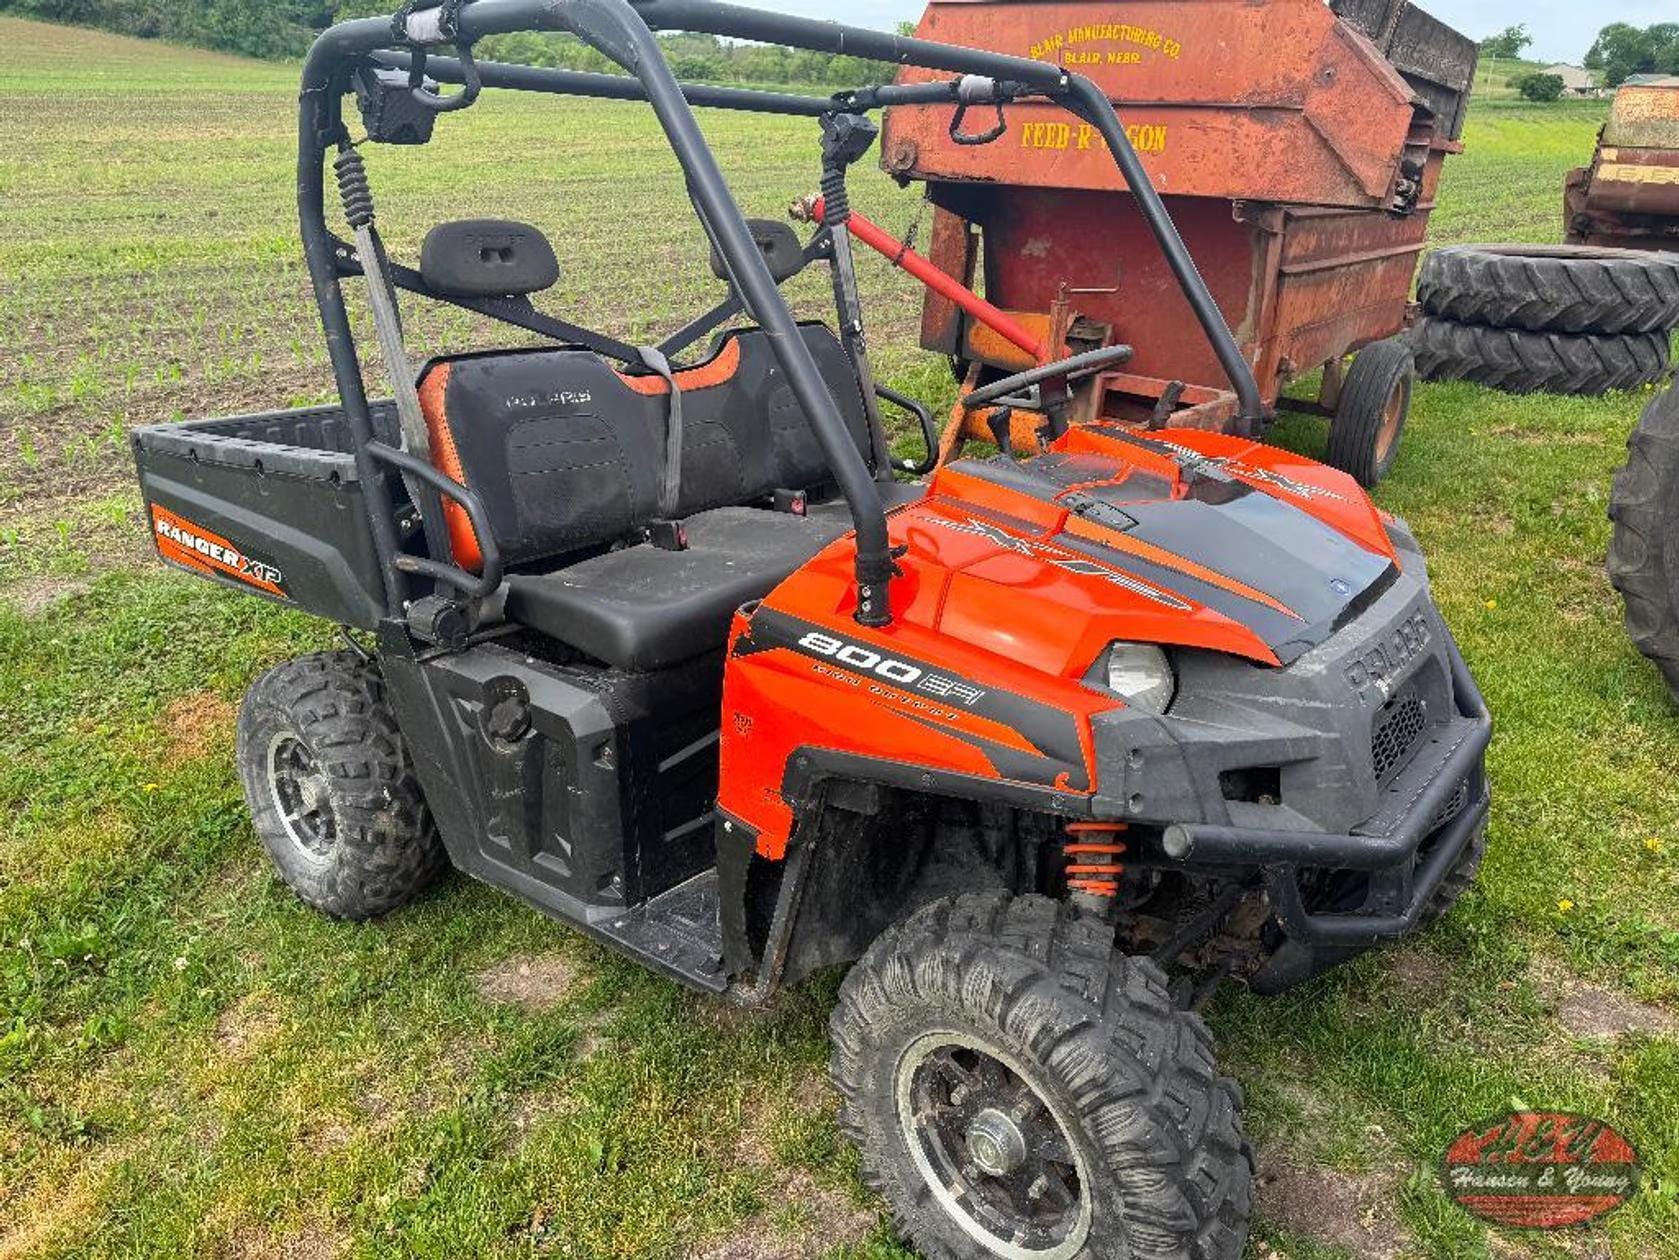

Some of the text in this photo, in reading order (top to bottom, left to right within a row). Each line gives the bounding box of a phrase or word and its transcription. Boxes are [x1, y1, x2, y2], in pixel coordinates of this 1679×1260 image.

[1029, 24, 1182, 60] BLAIR MANUFACTURING CO.
[798, 632, 922, 683] 800
